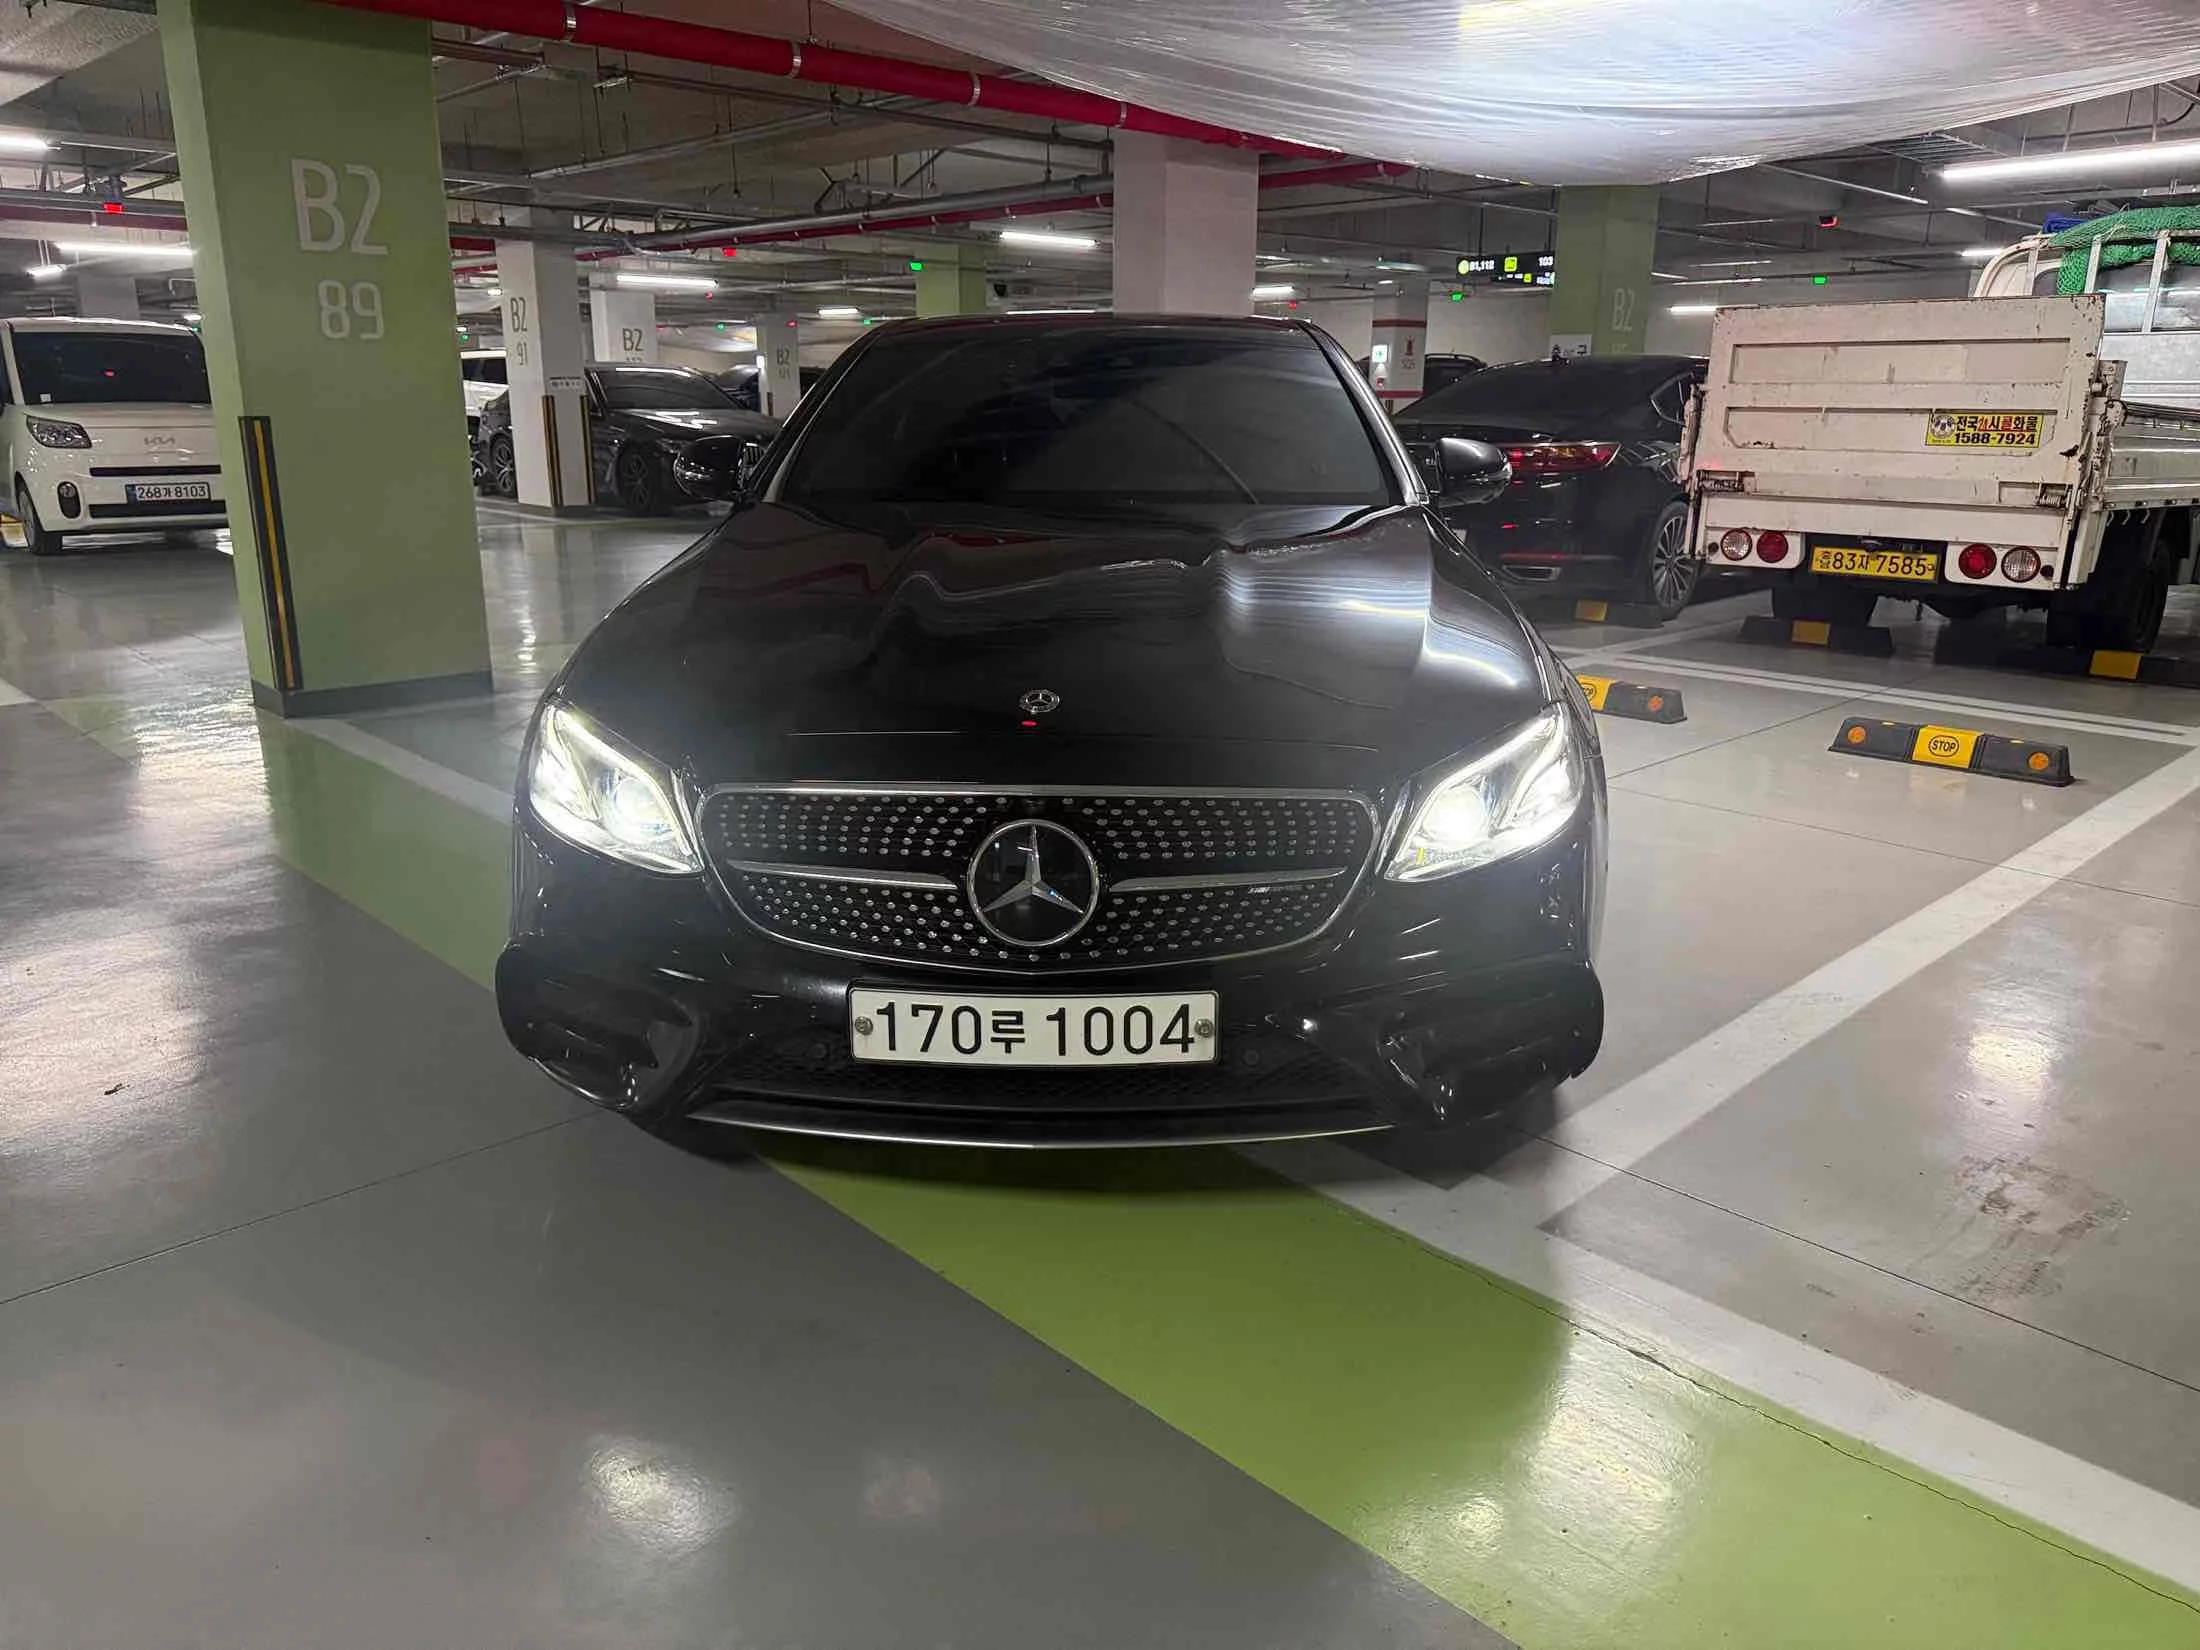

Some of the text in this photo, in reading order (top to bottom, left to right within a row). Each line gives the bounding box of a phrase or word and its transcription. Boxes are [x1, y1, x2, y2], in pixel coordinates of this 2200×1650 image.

[291, 159, 388, 255] B2
[318, 279, 385, 340] 89
[510, 297, 528, 332] B2
[1612, 287, 1634, 331] B2
[622, 328, 645, 351] B2
[776, 349, 791, 366] B2
[1954, 432, 2035, 445] 1588-7924
[1875, 554, 1927, 576] 7585
[1932, 740, 1956, 752] STOP
[876, 1001, 1195, 1056] 170루 1004
